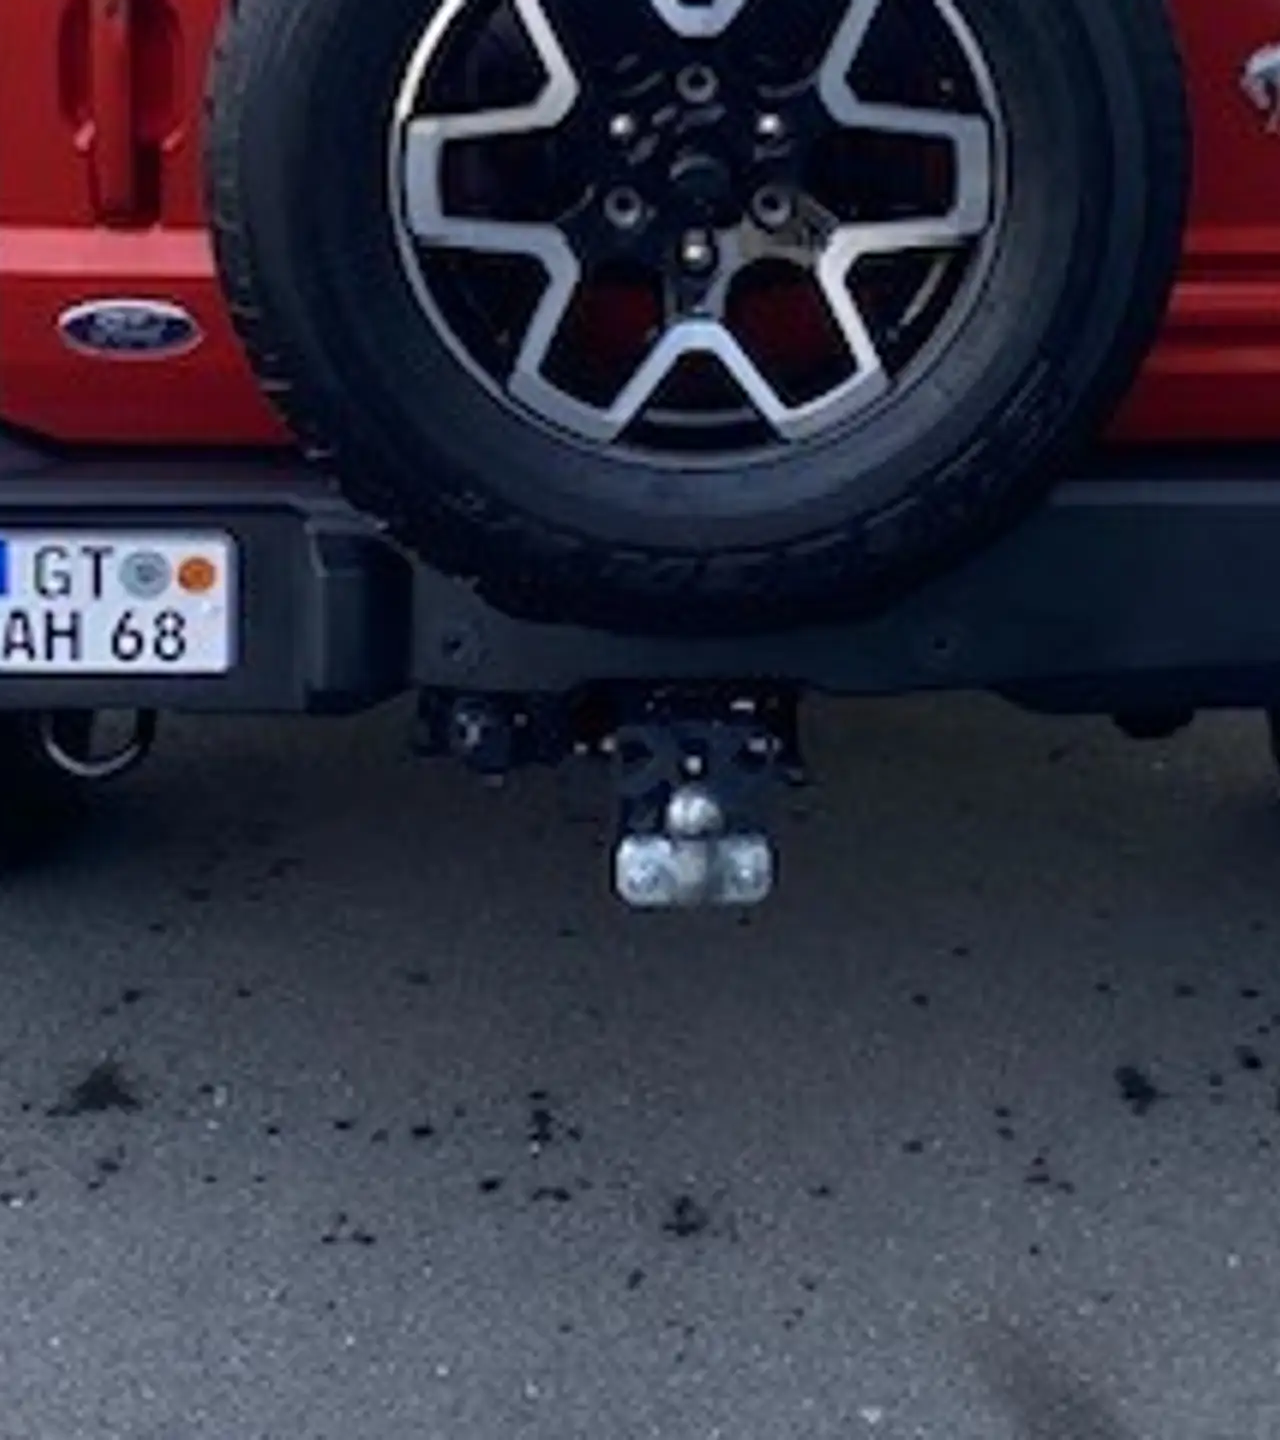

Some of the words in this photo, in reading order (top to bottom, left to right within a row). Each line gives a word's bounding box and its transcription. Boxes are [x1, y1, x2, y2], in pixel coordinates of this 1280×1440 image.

[33, 545, 114, 600] GT
[2, 610, 81, 662] AH
[110, 610, 187, 662] 68
